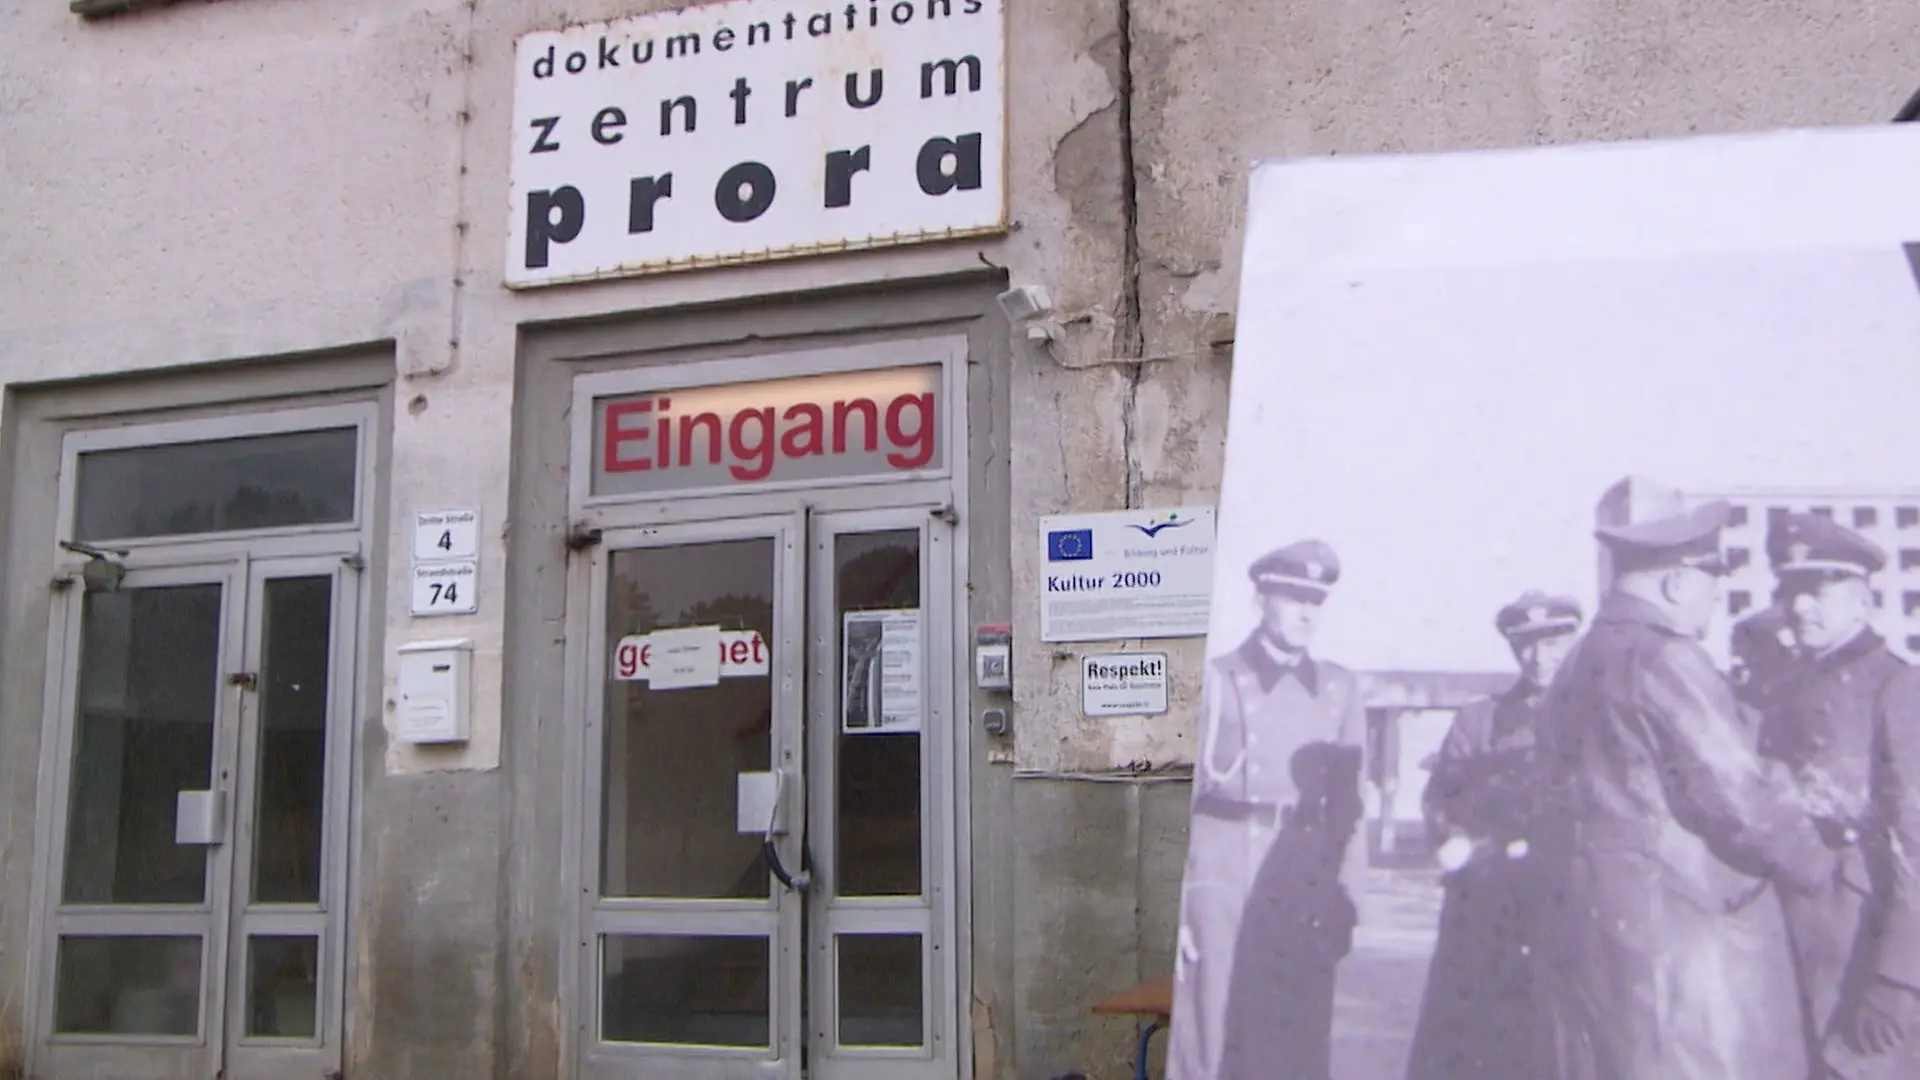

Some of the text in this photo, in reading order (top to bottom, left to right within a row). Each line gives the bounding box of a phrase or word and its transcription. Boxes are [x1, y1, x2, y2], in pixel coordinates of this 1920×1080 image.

[532, 0, 984, 79] dokumentations
[529, 53, 982, 154] zentrum
[525, 131, 982, 269] prora
[603, 391, 936, 481] Eingang
[437, 529, 453, 551] 4
[429, 583, 458, 605] 74
[1048, 571, 1161, 593] Kultur 2000
[1088, 658, 1161, 681] Respekt!
